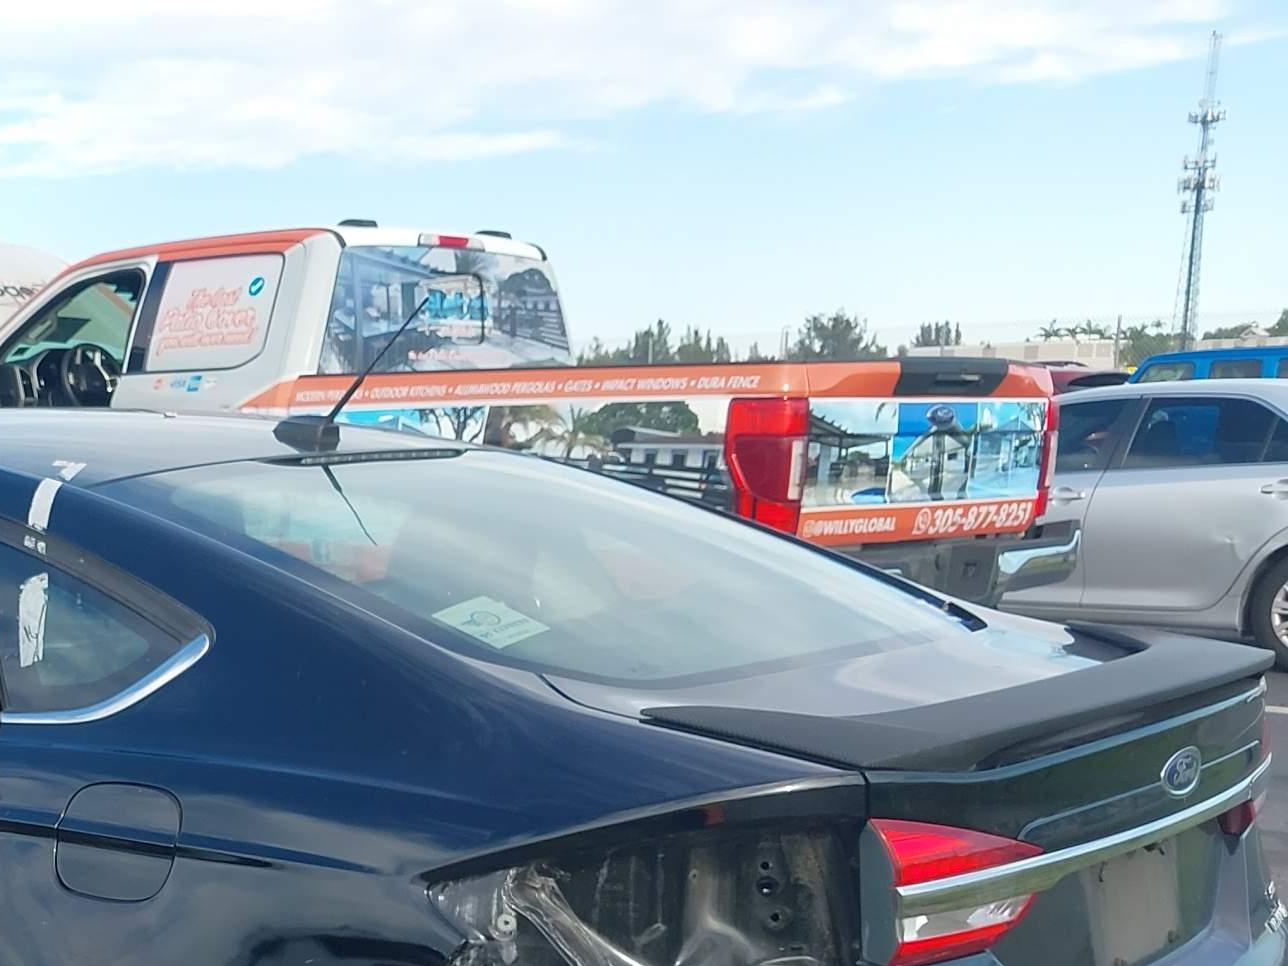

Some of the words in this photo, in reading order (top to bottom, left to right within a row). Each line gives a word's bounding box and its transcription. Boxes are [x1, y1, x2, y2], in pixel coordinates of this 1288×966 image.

[512, 381, 555, 394] PERGOLAS
[564, 379, 592, 392] GATES
[601, 378, 636, 391] IMPACT
[636, 377, 688, 390] WINDOWS
[697, 376, 725, 389] DURA
[726, 375, 761, 388] FENCE
[928, 502, 1032, 534] 305-877-8251
